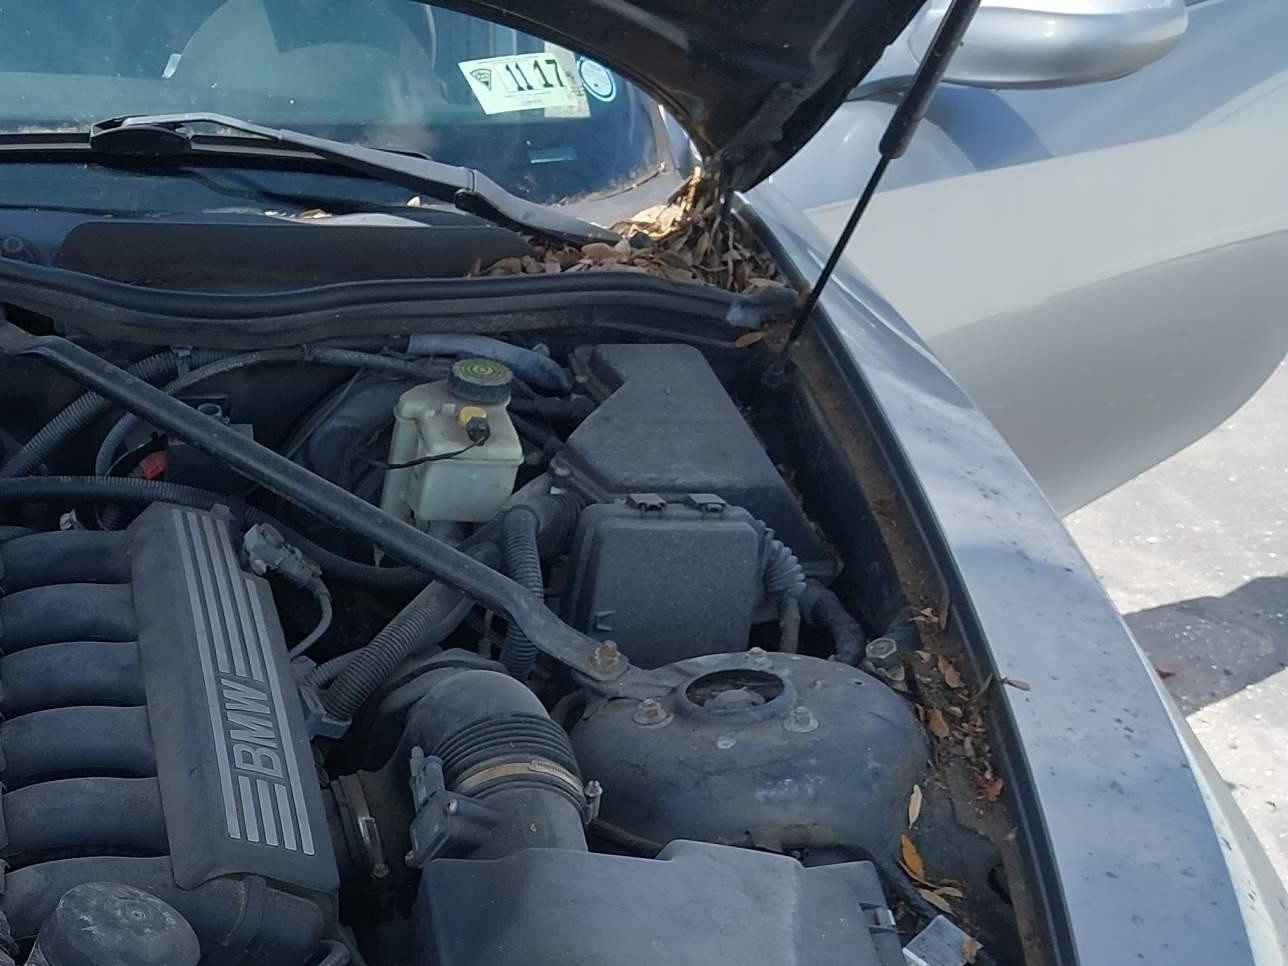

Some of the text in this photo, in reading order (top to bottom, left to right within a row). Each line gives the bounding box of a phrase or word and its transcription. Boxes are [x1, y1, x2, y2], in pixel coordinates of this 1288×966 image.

[505, 59, 564, 92] 11 17
[220, 678, 284, 778] BMW
